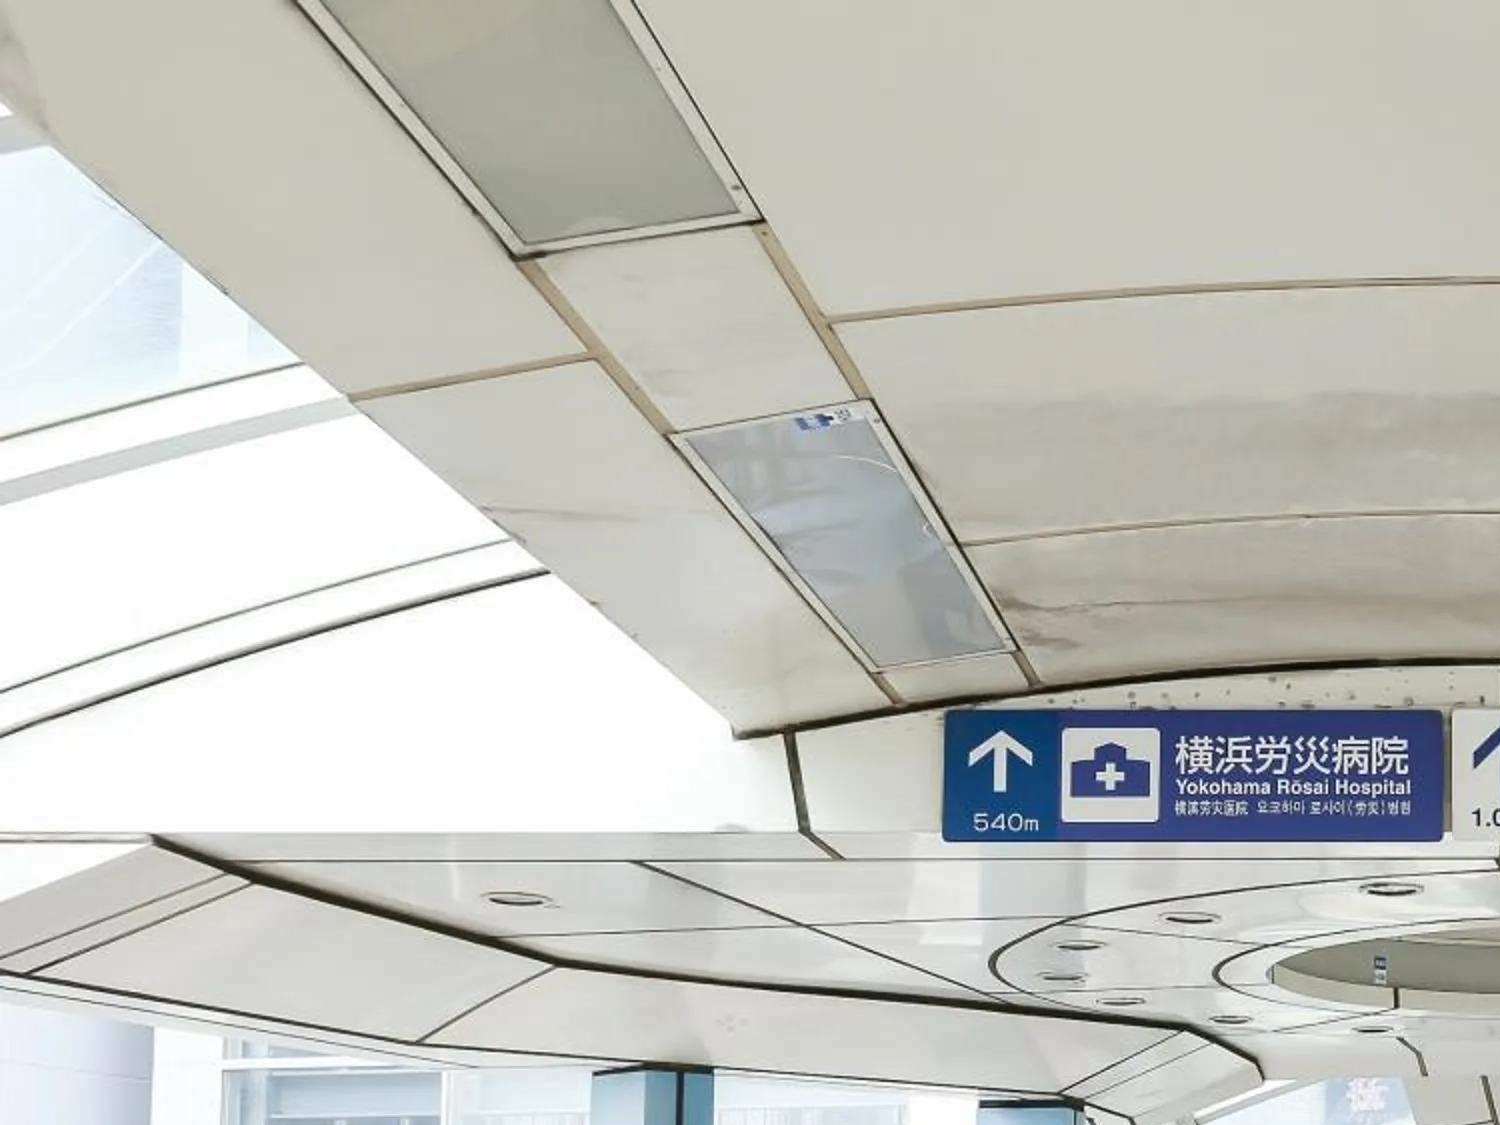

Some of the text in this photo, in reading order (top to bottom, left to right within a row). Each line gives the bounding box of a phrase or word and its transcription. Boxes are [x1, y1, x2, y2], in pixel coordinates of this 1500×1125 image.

[1175, 736, 1410, 776] 横浜労災病院
[1175, 778, 1411, 799] Yokohama Rōsai Hospital
[973, 812, 1039, 833] 540m
